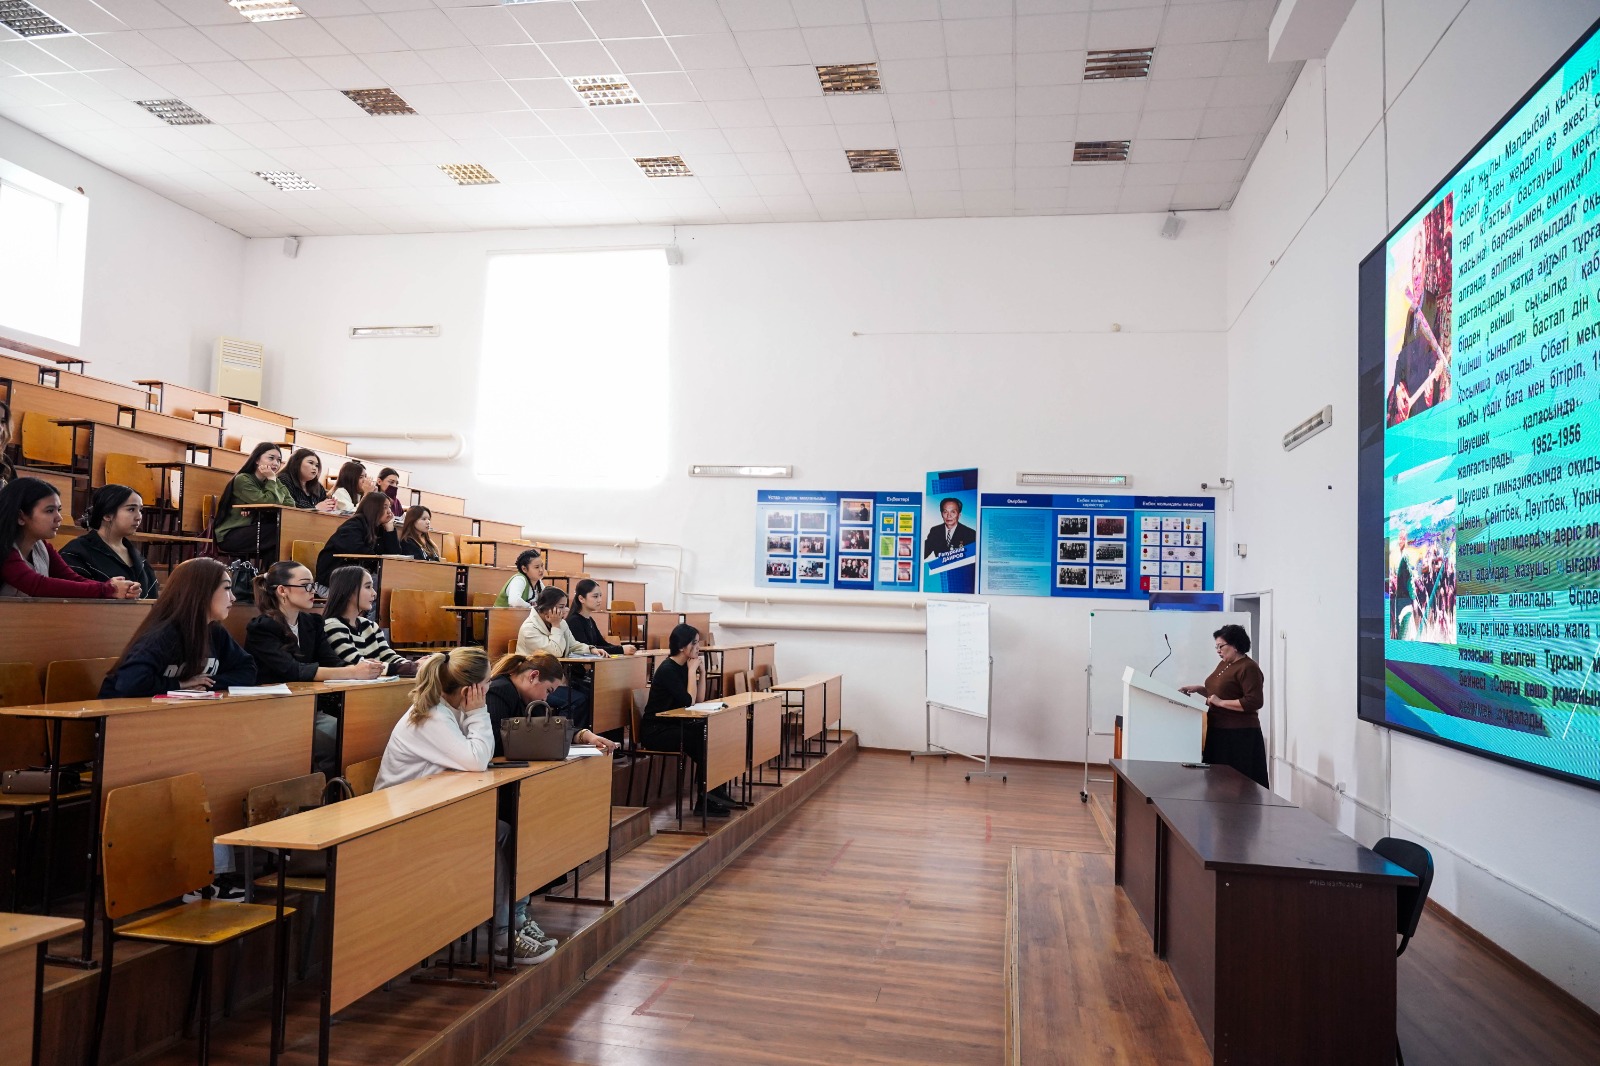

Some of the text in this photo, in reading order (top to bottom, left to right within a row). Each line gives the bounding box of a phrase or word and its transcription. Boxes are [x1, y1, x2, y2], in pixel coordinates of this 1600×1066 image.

[1508, 141, 1541, 185] жердегі
[1546, 132, 1557, 151] өз
[1562, 98, 1588, 136] әкесі
[1459, 231, 1474, 253] төрт
[1518, 156, 1562, 204] бастауыш
[1510, 268, 1534, 295] жатқа
[1458, 329, 1481, 354] бірден
[1490, 304, 1515, 334] екінші
[1486, 329, 1527, 363] сыныптан
[1532, 307, 1565, 338] бастап
[1572, 294, 1589, 320] дін
[1540, 331, 1570, 362] Сібеті
[1506, 389, 1524, 408] баға
[1528, 379, 1545, 398] мен
[1494, 466, 1562, 497] гимназиясында
[1513, 622, 1560, 640] жазықсыз
